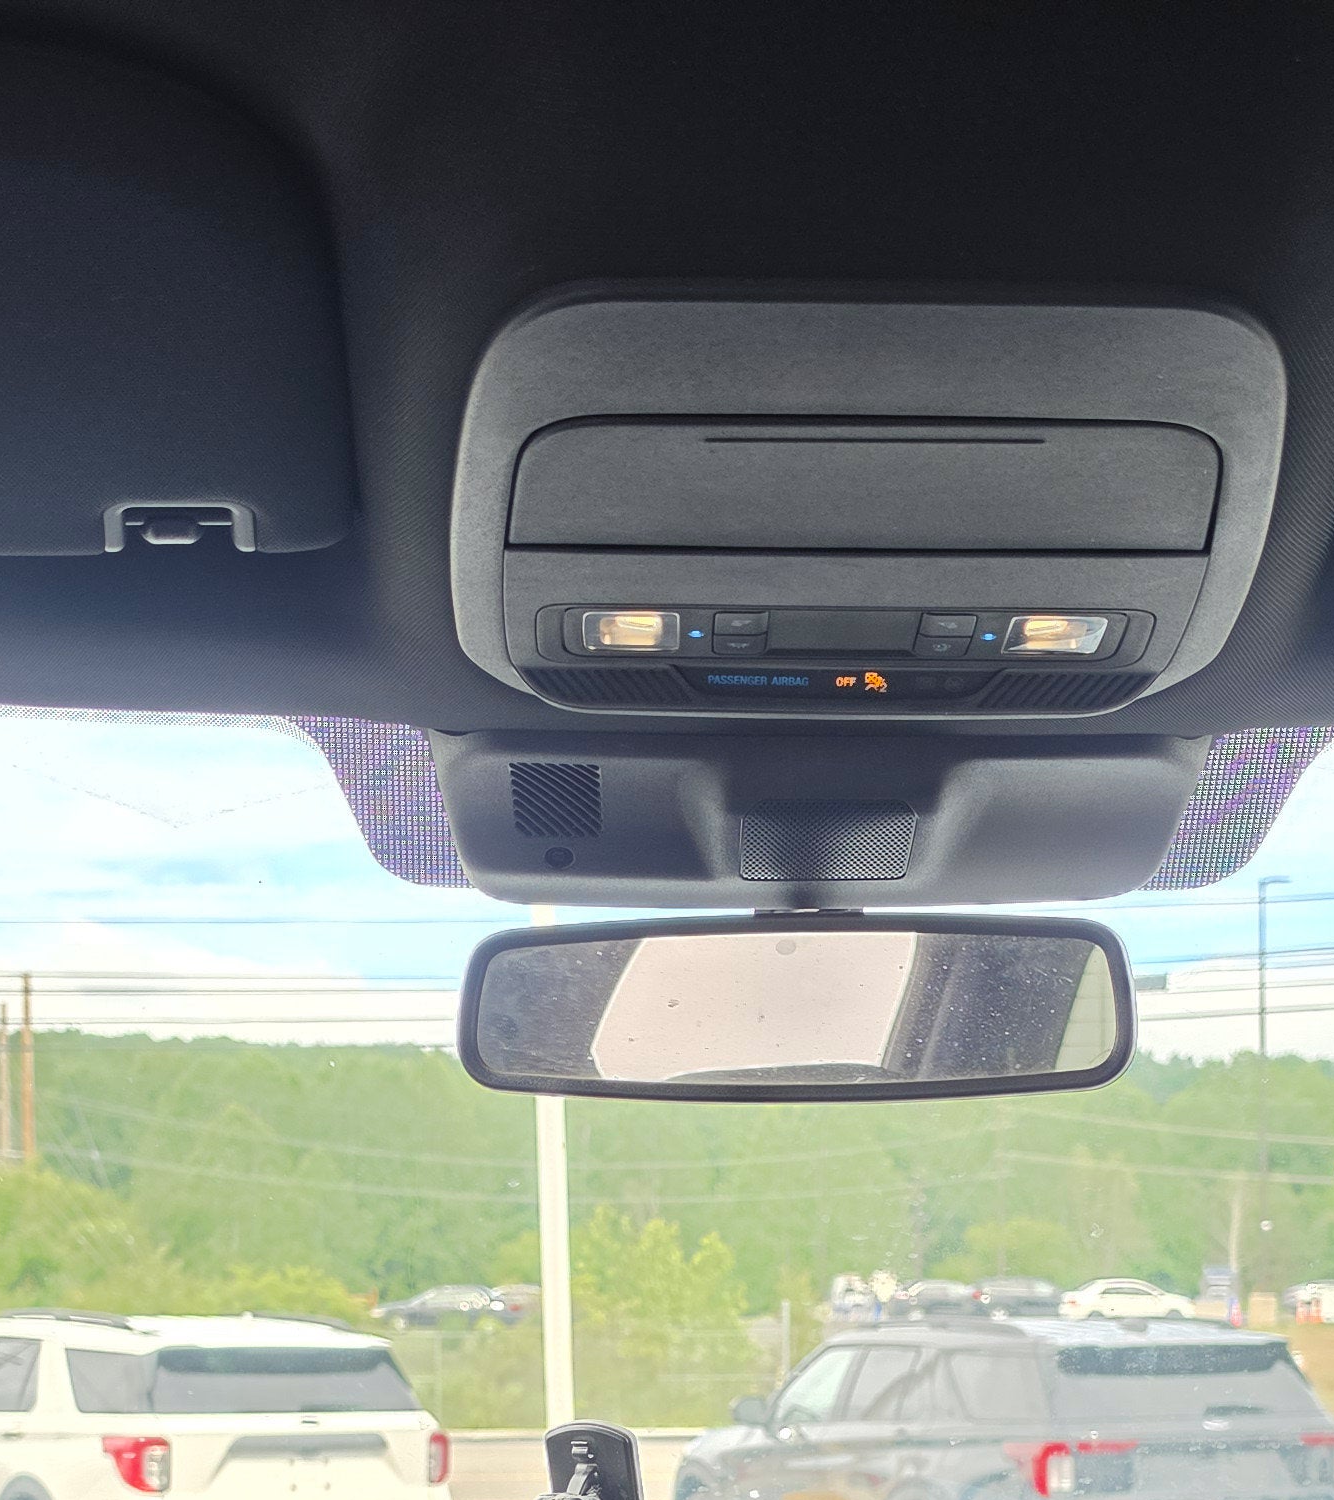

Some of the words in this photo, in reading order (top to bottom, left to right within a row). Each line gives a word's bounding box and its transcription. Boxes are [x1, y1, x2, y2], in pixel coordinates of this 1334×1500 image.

[707, 674, 768, 686] PASSENGER
[770, 676, 809, 687] AIRBAG
[835, 676, 857, 687] OFF
